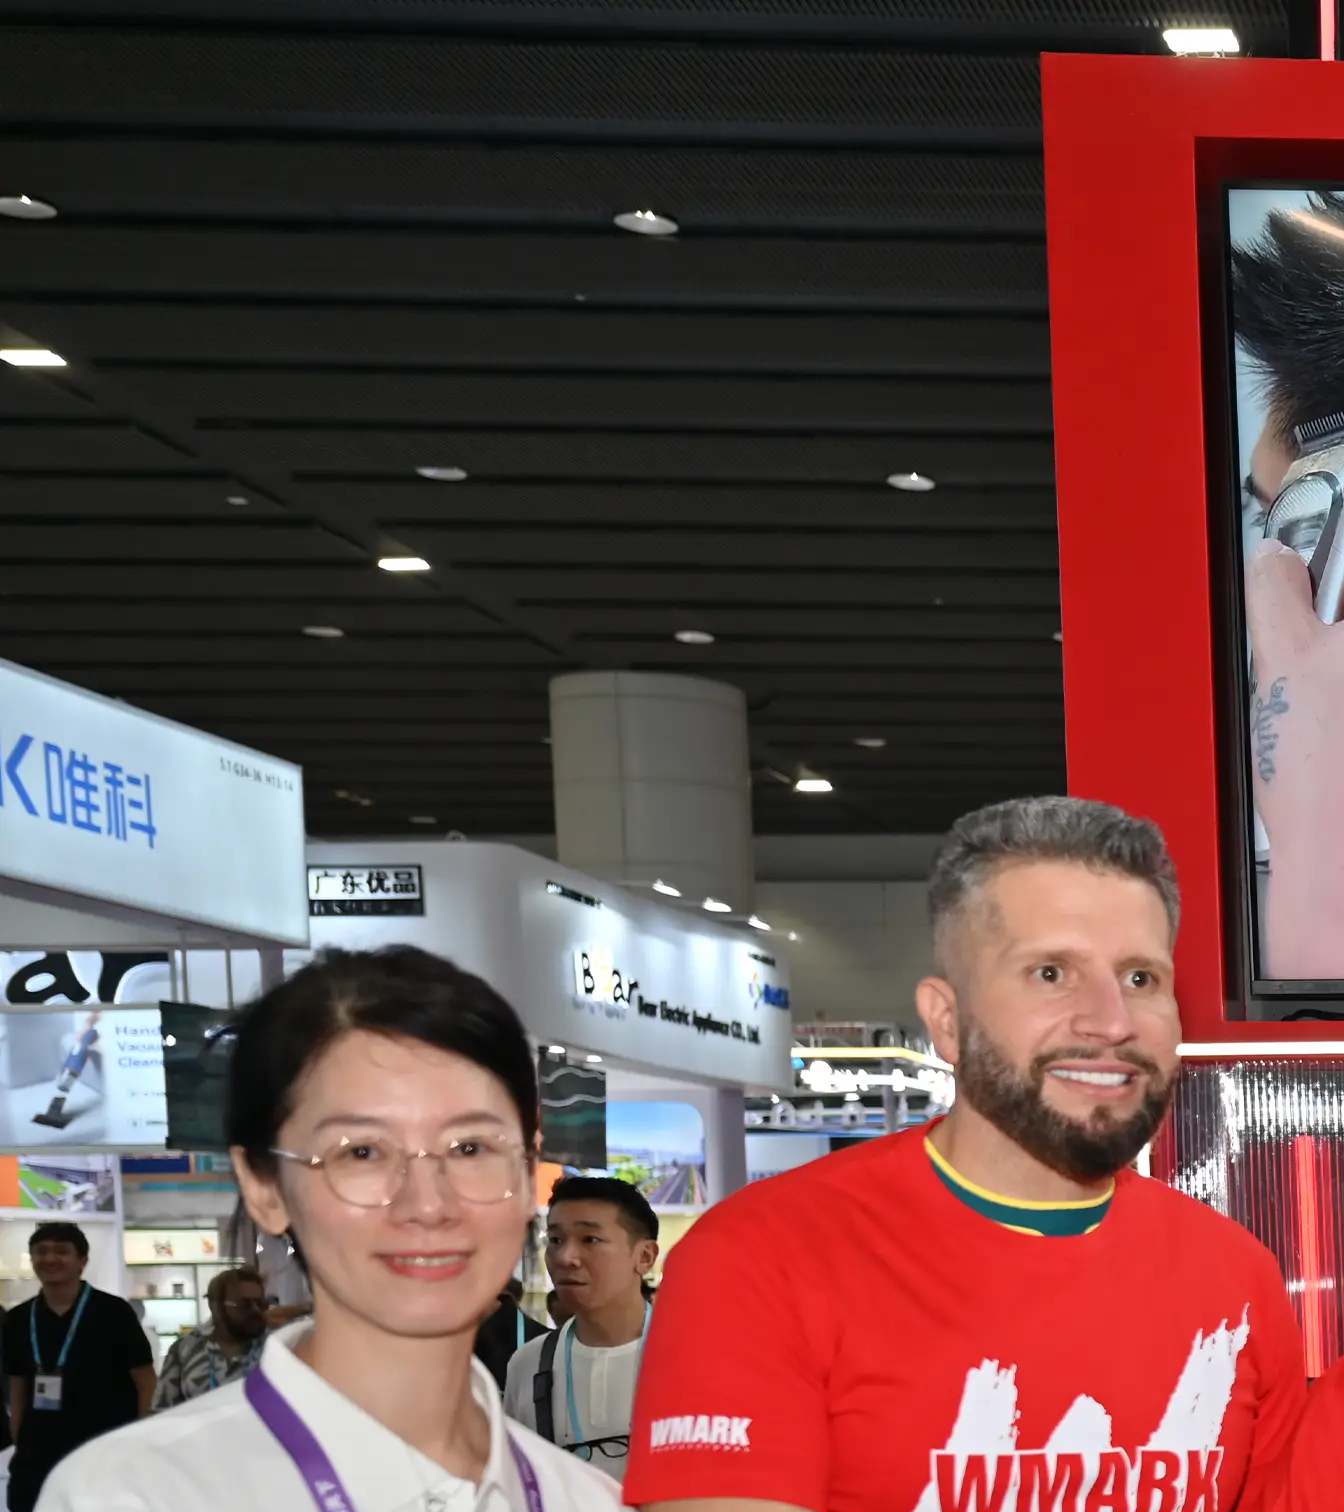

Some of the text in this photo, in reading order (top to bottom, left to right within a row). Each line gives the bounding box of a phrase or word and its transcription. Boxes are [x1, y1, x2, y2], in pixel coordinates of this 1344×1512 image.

[315, 870, 416, 894] 广东优品
[581, 952, 638, 1005] Bar
[650, 1414, 753, 1448] WMARK
